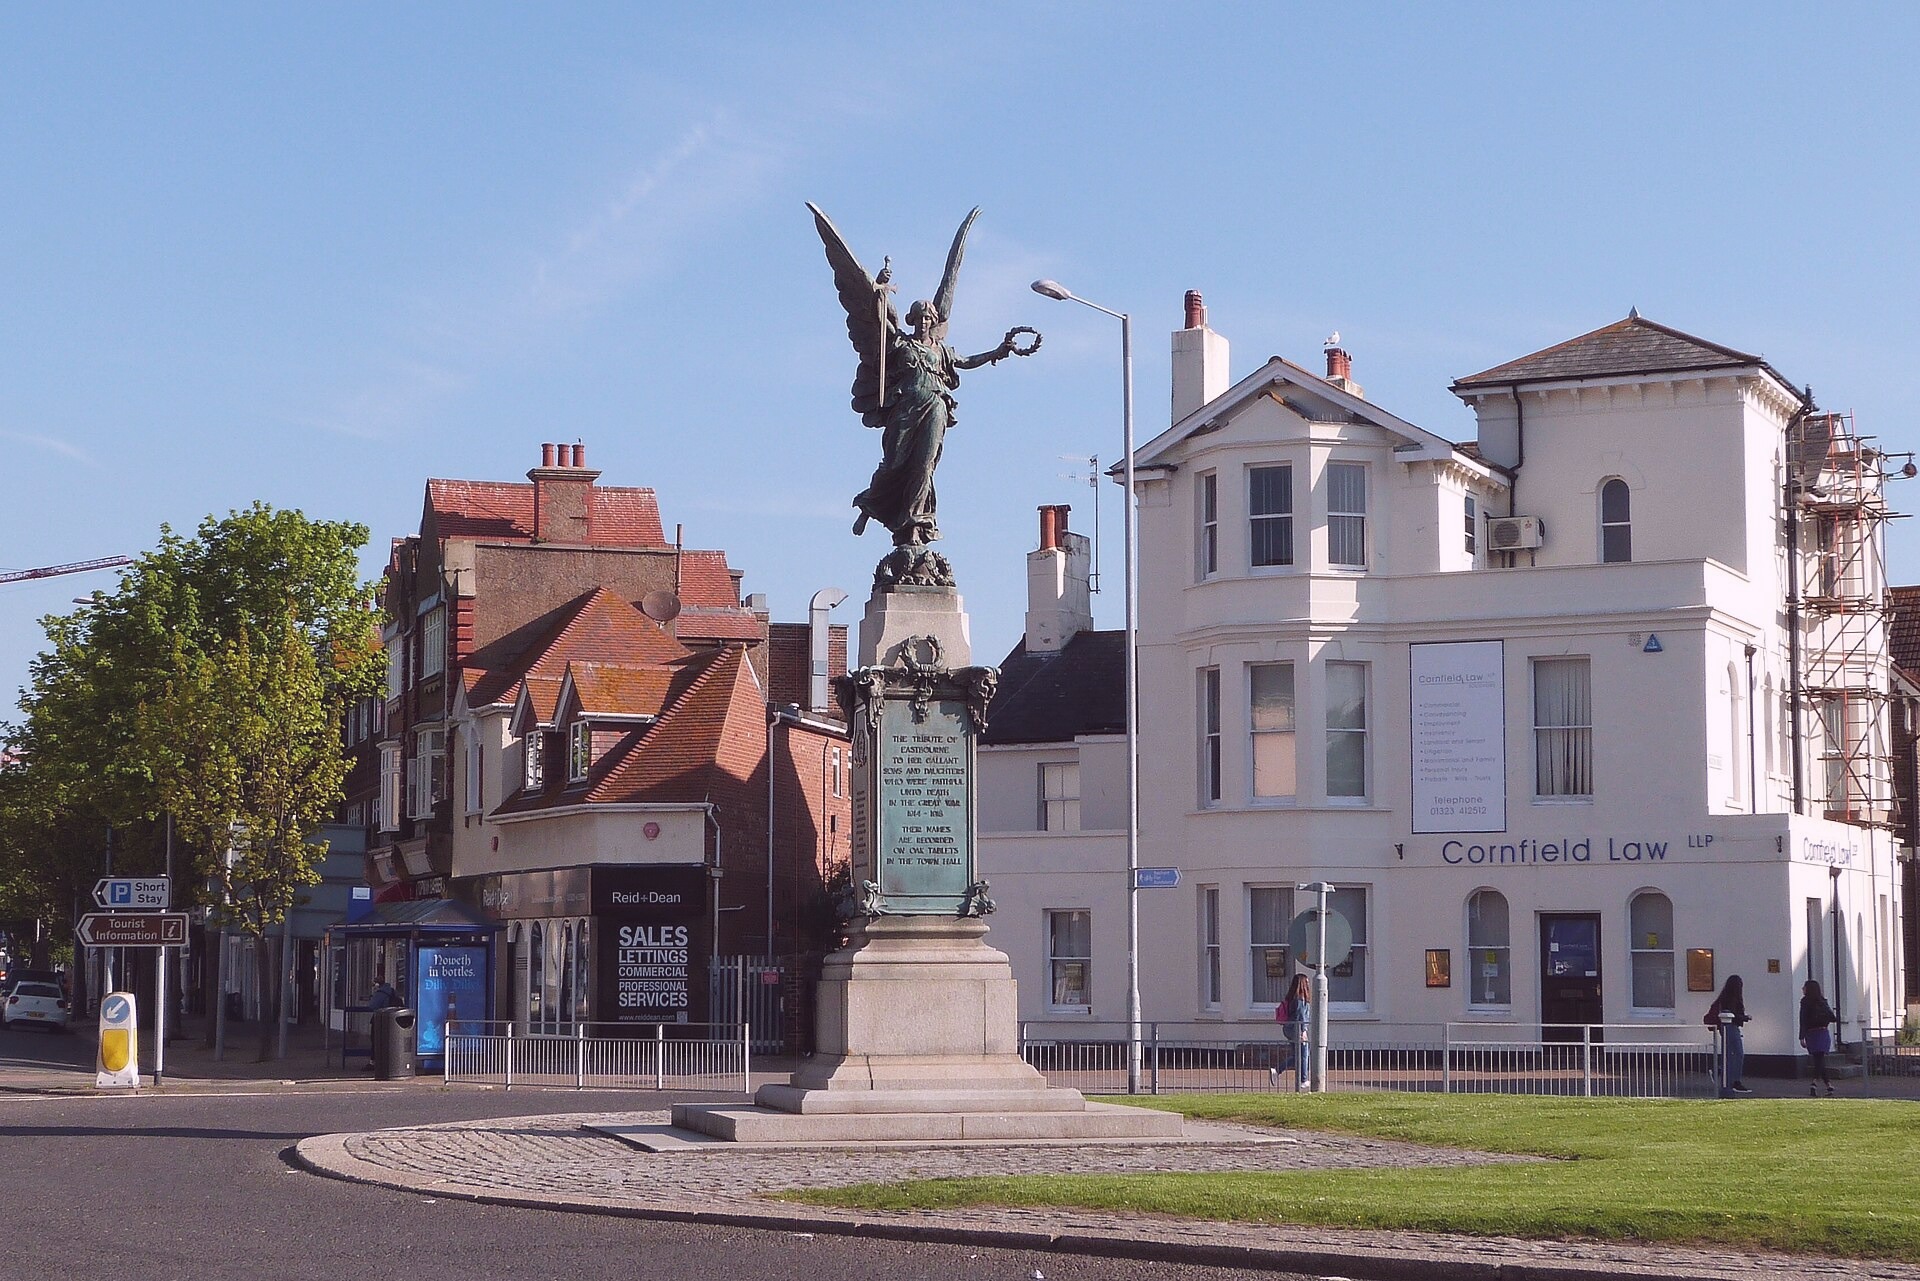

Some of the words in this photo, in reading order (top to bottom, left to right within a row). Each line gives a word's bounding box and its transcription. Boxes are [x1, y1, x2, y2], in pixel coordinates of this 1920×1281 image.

[1418, 674, 1462, 683] Cornfield
[1466, 674, 1484, 682] Law
[892, 735, 908, 743] THE
[912, 735, 944, 744] TRIBUTE
[946, 736, 958, 744] OF
[900, 746, 950, 754] EASTBOURNE
[907, 756, 922, 764] HER
[926, 756, 960, 764] GALLANT
[900, 788, 922, 796] UNTO
[926, 788, 950, 796] DEATH
[1434, 796, 1484, 805] Telephone
[1430, 807, 1455, 816] 01323
[1458, 806, 1487, 815] 412512
[898, 836, 912, 844] ARE
[916, 836, 954, 844] RECORDED
[892, 846, 906, 854] ON
[909, 846, 925, 854] OAK
[928, 846, 959, 854] TABLETS
[1442, 838, 1591, 864] Cornfield
[1608, 837, 1669, 861] Law
[1688, 834, 1714, 848] LLP
[917, 858, 940, 866] TOWN
[134, 882, 166, 892] Short
[137, 894, 163, 905] Stay
[108, 918, 146, 929] Tourist
[96, 930, 158, 941] Information
[618, 926, 688, 947] SALES
[618, 950, 688, 964] LETTINGS
[428, 966, 439, 977] in
[442, 966, 476, 977] bottles.
[618, 966, 688, 978] COMMERCIAL
[618, 981, 688, 992] PROFESSIONAL
[618, 992, 688, 1008] SERVICES
